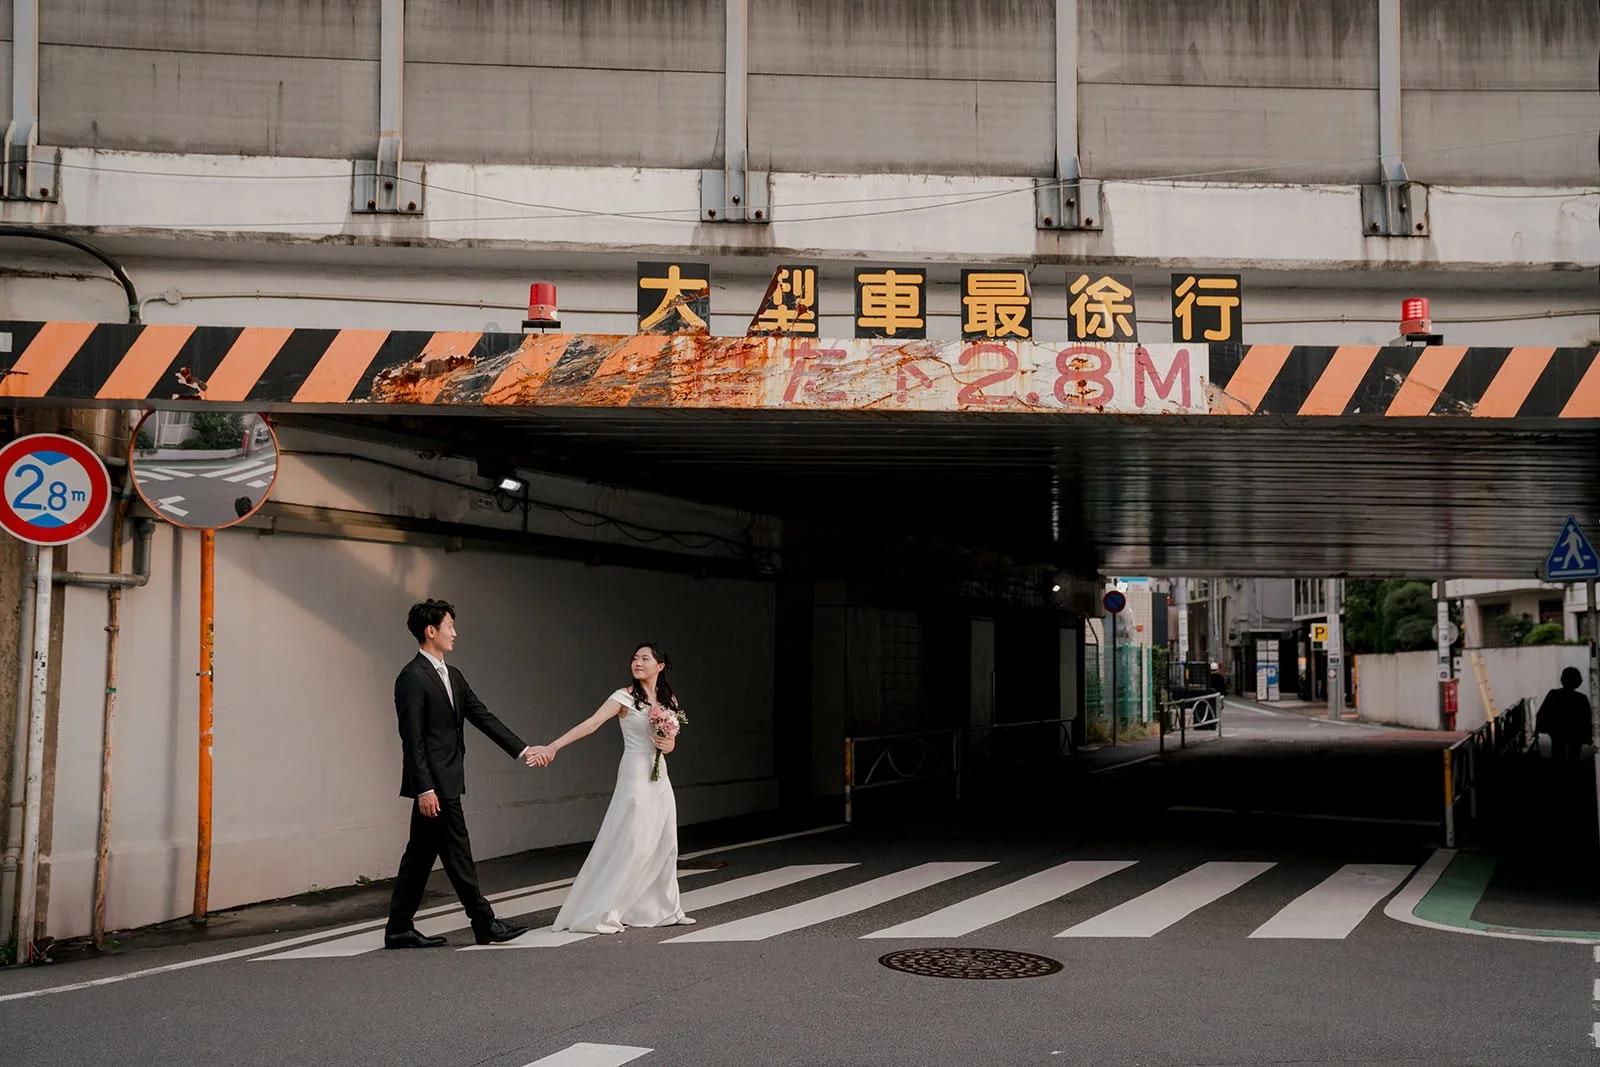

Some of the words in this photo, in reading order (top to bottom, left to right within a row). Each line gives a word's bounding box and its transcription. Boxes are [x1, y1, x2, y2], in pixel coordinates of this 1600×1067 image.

[640, 265, 1239, 341] 大型車最徐行
[12, 463, 86, 511] 2.8m
[1314, 626, 1325, 639] P
